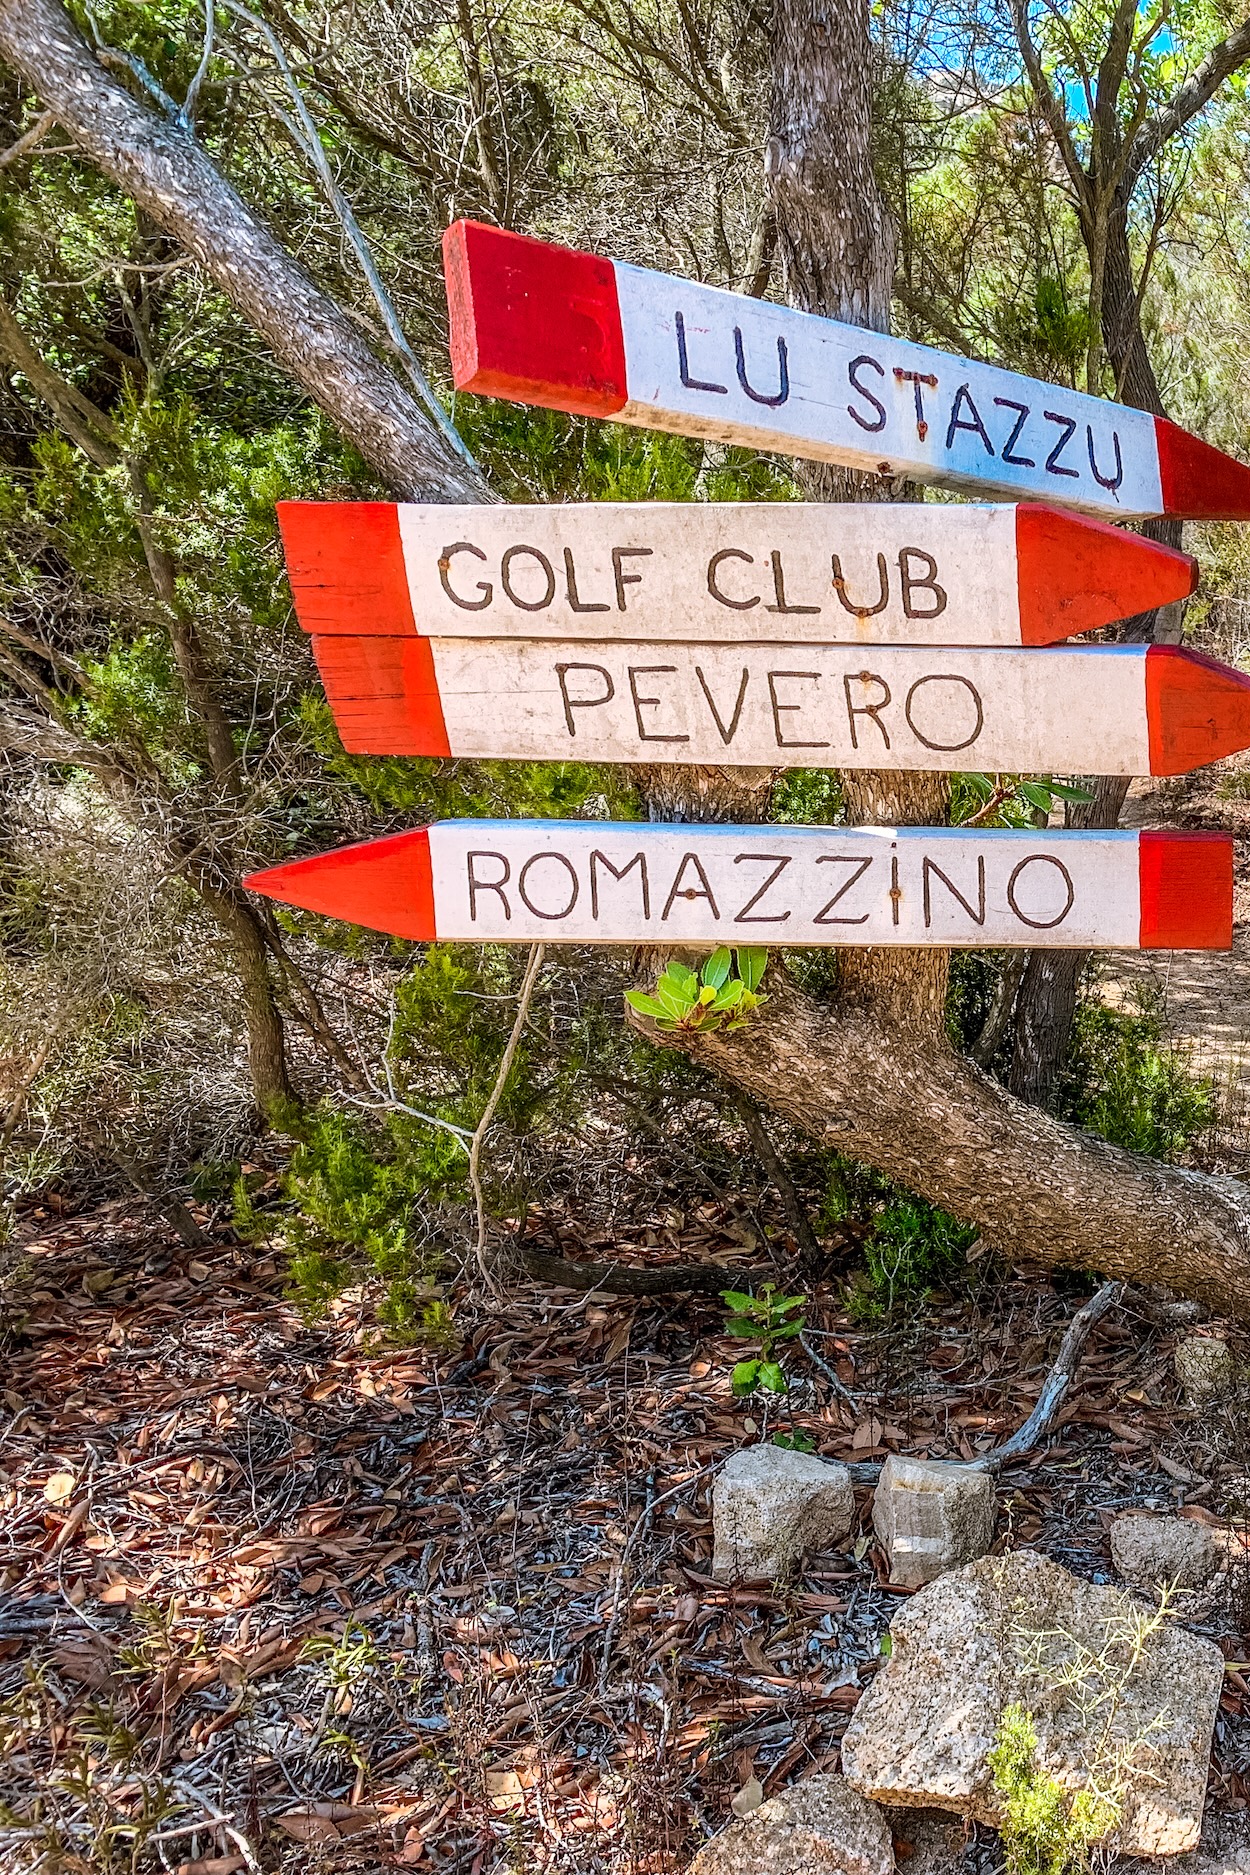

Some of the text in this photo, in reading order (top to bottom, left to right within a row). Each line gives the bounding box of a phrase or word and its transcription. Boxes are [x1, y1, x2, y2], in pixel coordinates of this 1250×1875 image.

[674, 310, 1124, 491] LU STAZZU
[438, 540, 948, 620] GOLF CLUB
[554, 660, 985, 752] PEVERO
